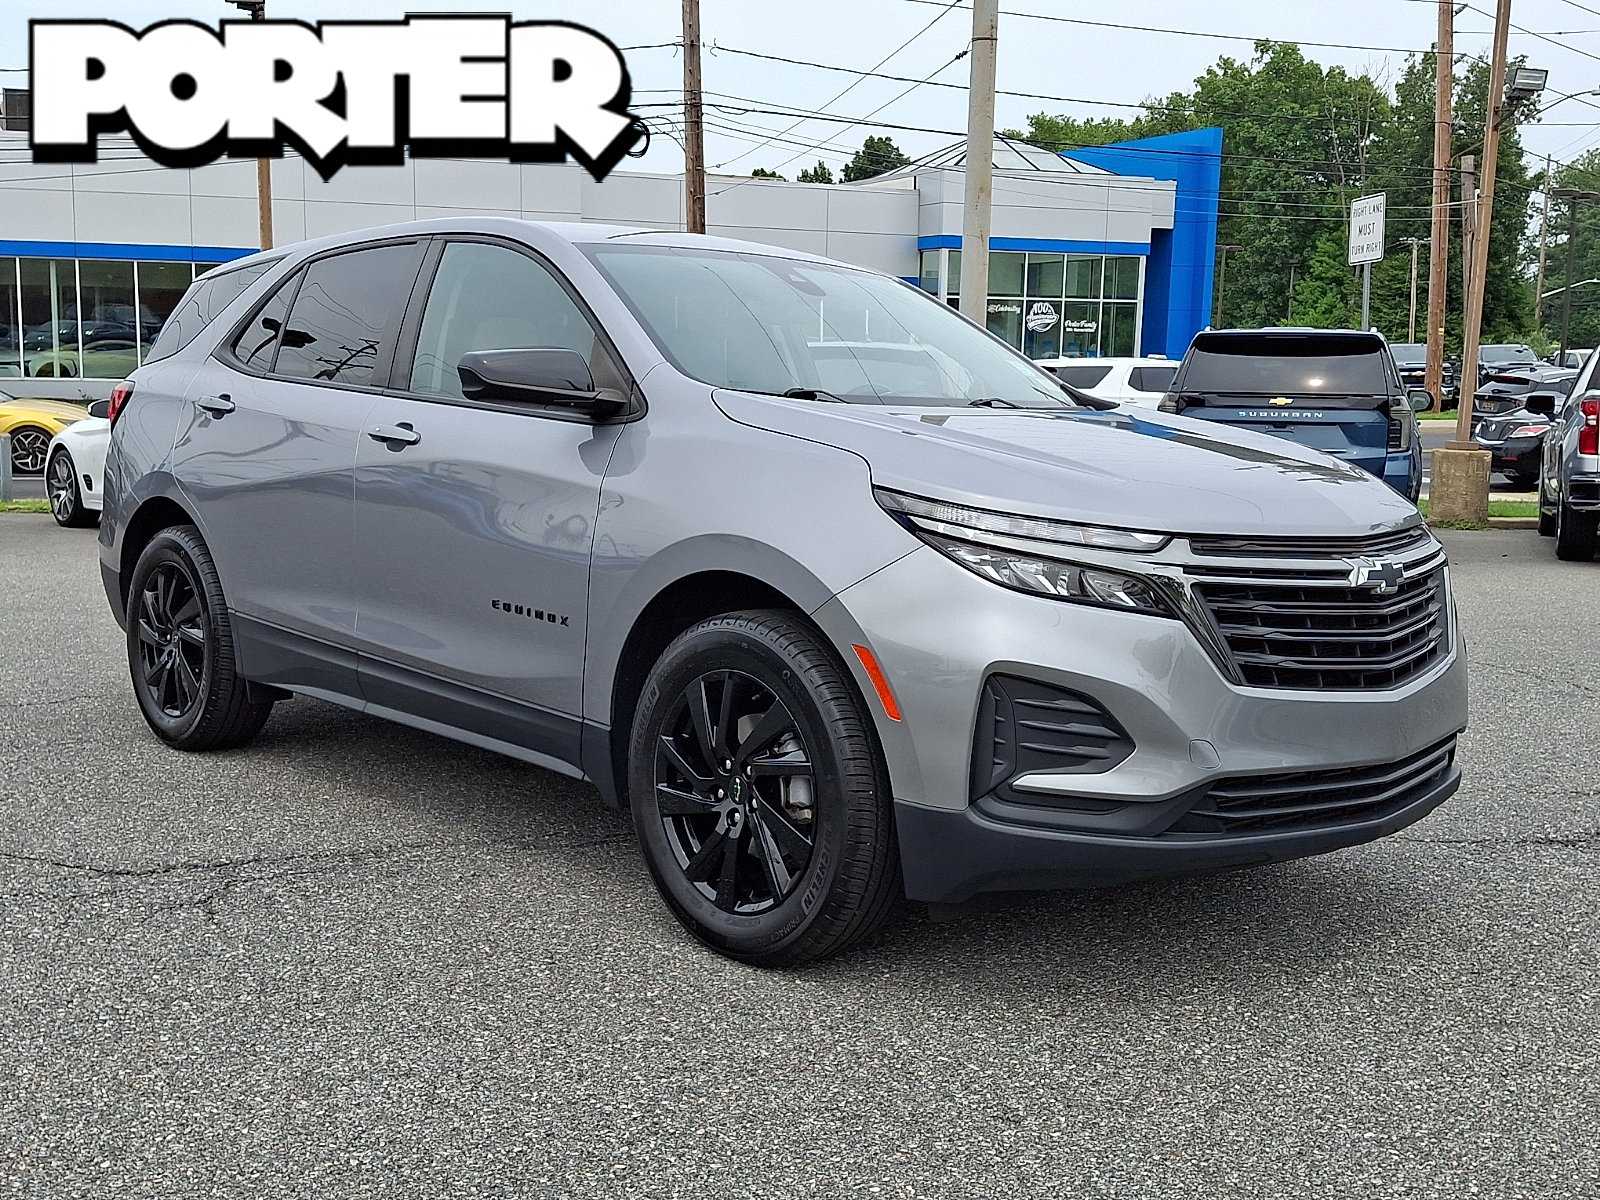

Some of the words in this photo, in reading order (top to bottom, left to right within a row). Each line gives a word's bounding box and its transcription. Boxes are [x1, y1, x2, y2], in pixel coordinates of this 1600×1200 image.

[1353, 206, 1367, 218] RIGHT
[1368, 203, 1383, 215] LANE
[1358, 222, 1375, 237] MUST
[1351, 244, 1364, 256] TURN
[1366, 241, 1381, 253] RIGHT
[491, 599, 569, 627] EQUINOX
